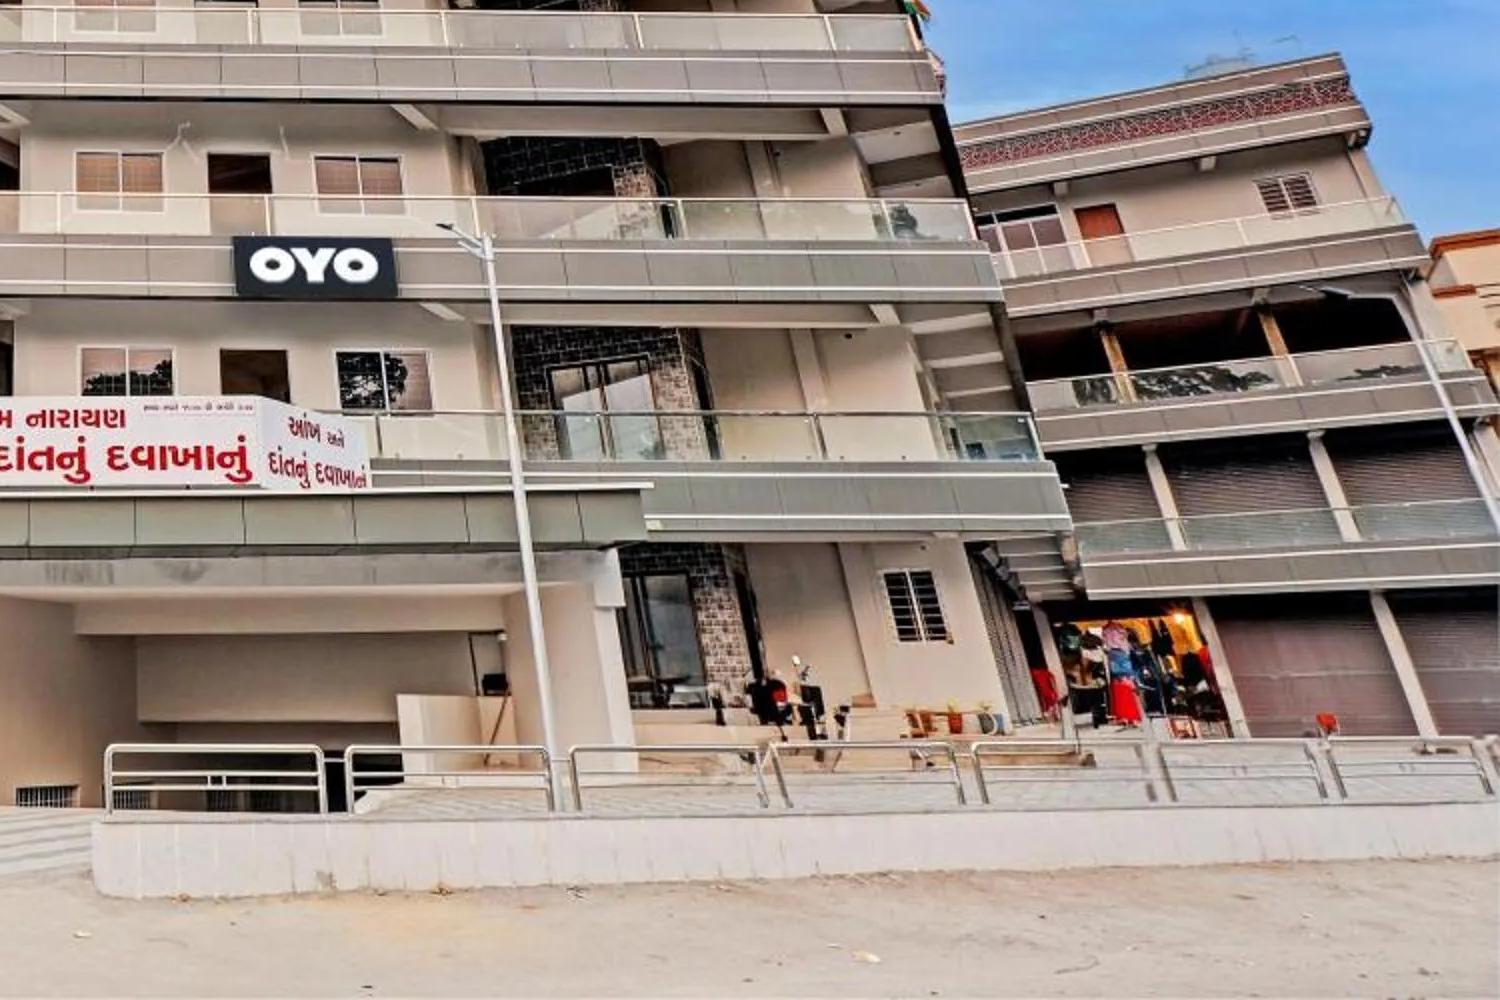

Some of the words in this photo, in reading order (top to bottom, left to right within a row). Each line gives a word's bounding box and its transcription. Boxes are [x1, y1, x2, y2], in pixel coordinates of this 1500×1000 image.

[249, 247, 379, 284] OYO
[25, 407, 127, 429] નારાયણ
[288, 412, 321, 444] આંખ
[106, 435, 253, 483] દવાખાનું
[268, 445, 311, 489] દાંતનું
